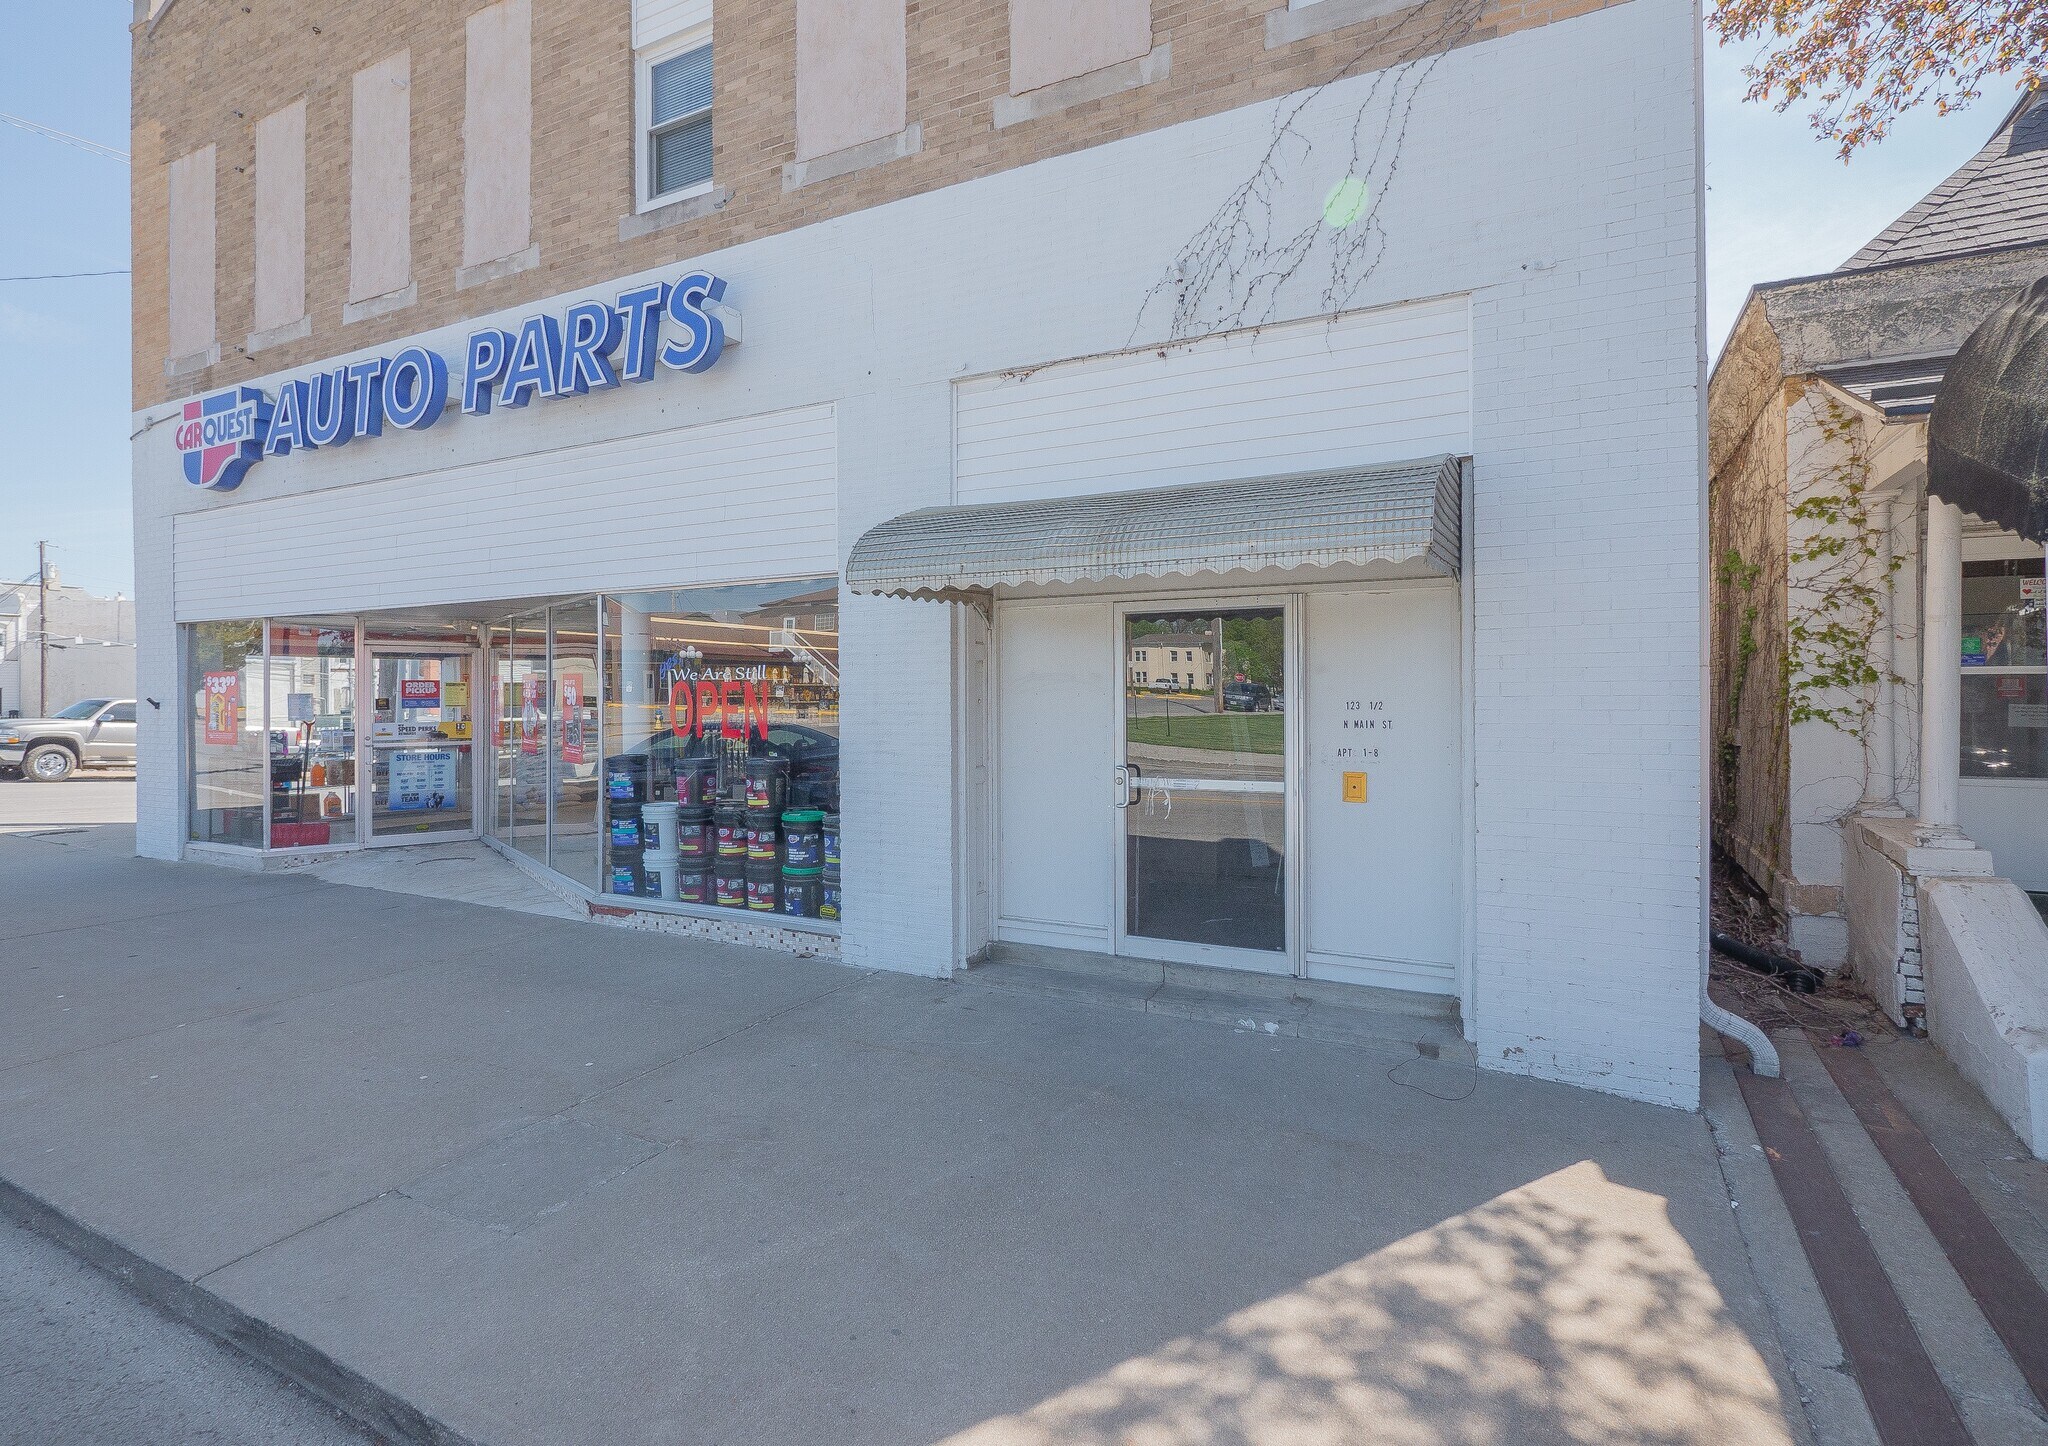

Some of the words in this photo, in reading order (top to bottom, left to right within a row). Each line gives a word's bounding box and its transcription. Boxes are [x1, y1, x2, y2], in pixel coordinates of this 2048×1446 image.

[263, 345, 438, 455] AUTO
[461, 269, 719, 416] PARTS
[175, 405, 254, 452] CARQUEST
[671, 668, 698, 681] We
[701, 667, 732, 680] Are
[735, 664, 767, 680] Still
[669, 680, 768, 741] OPEN
[1346, 701, 1360, 710] 123
[1370, 701, 1383, 710] 1/2
[1343, 720, 1349, 729] N
[1353, 720, 1375, 729] MAIN
[396, 754, 422, 762] STORE
[424, 753, 451, 761] HOURS
[1337, 748, 1352, 757] APT
[1363, 748, 1379, 757] 1-8
